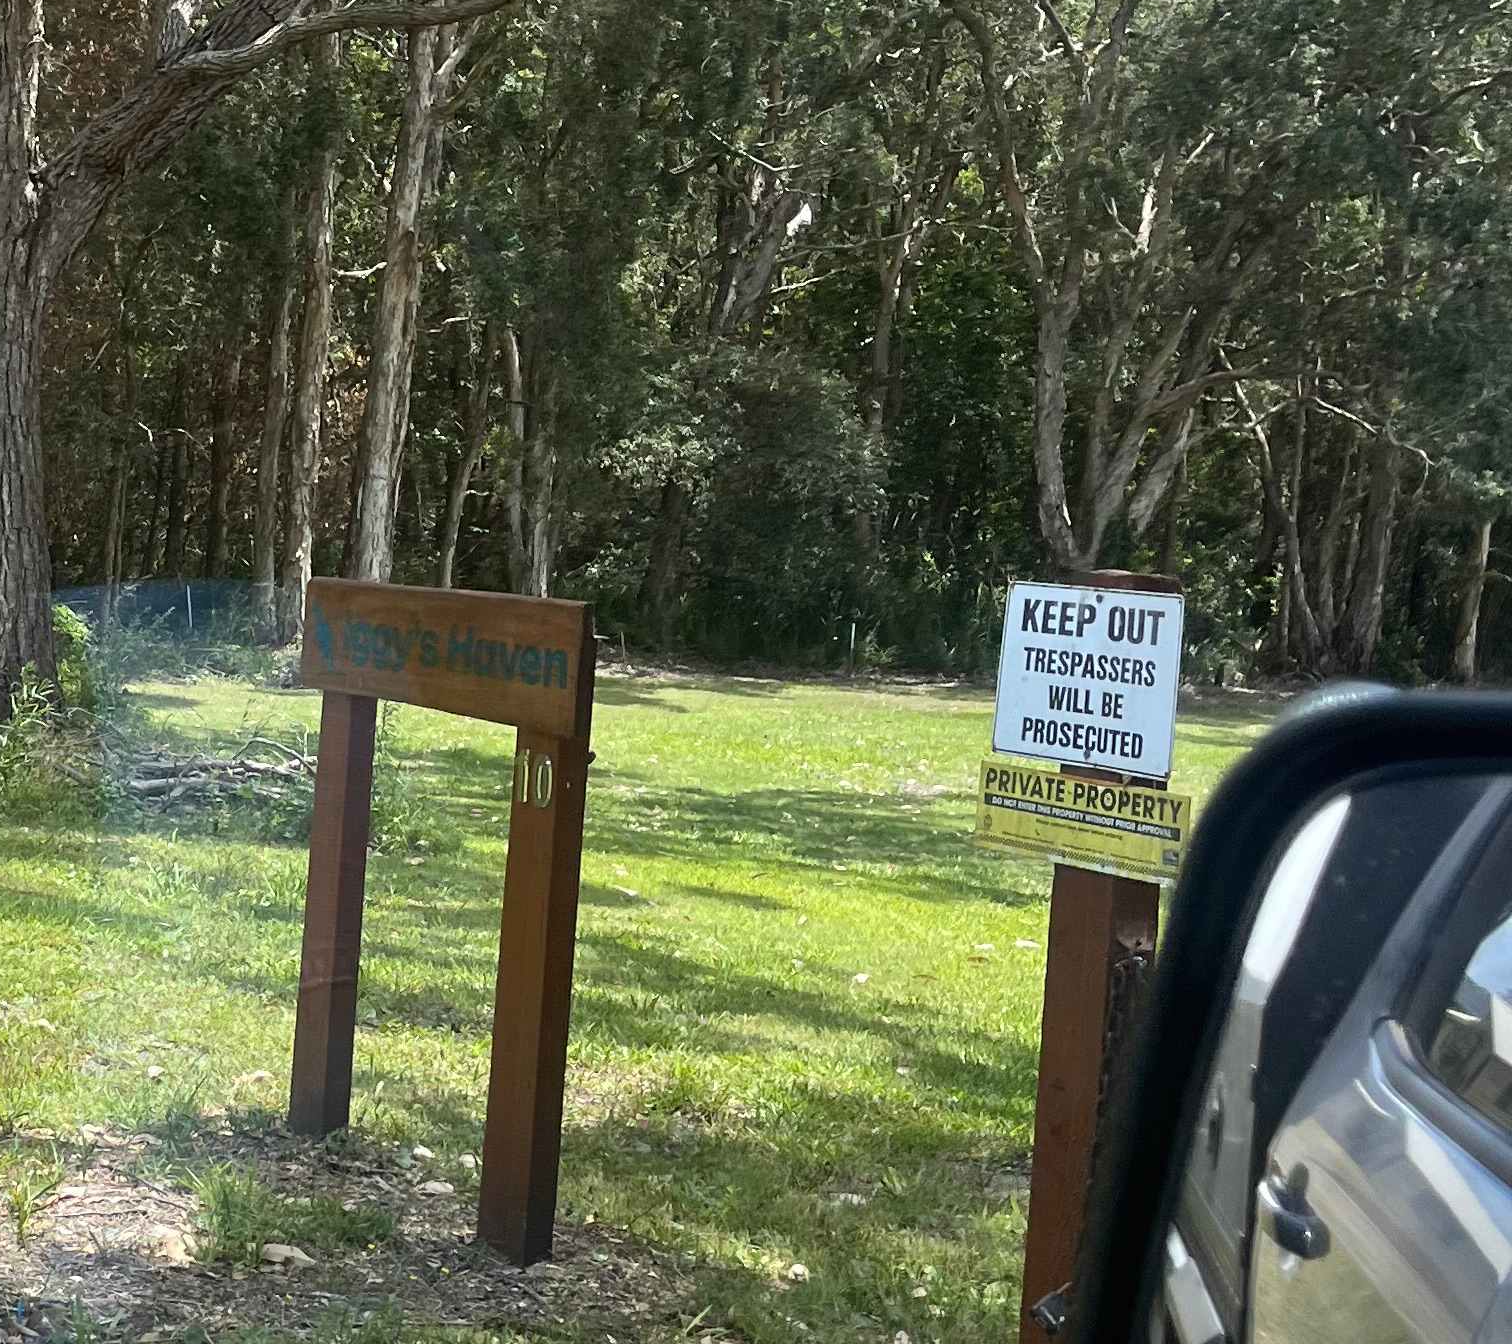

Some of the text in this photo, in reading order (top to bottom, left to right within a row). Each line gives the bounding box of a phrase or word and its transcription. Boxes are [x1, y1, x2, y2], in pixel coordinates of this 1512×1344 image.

[1021, 598, 1165, 645] KEEP OUT
[447, 624, 568, 689] Haven
[1024, 647, 1156, 687] TRESPASSERS
[1049, 685, 1124, 719] WILL BE
[1021, 717, 1144, 759] PROSECUTED
[519, 750, 553, 807] 10
[985, 768, 1183, 823] PRIVATE PROPERTY
[1051, 807, 1084, 822] PROPERTY
[1137, 823, 1172, 837] APPROVAL
